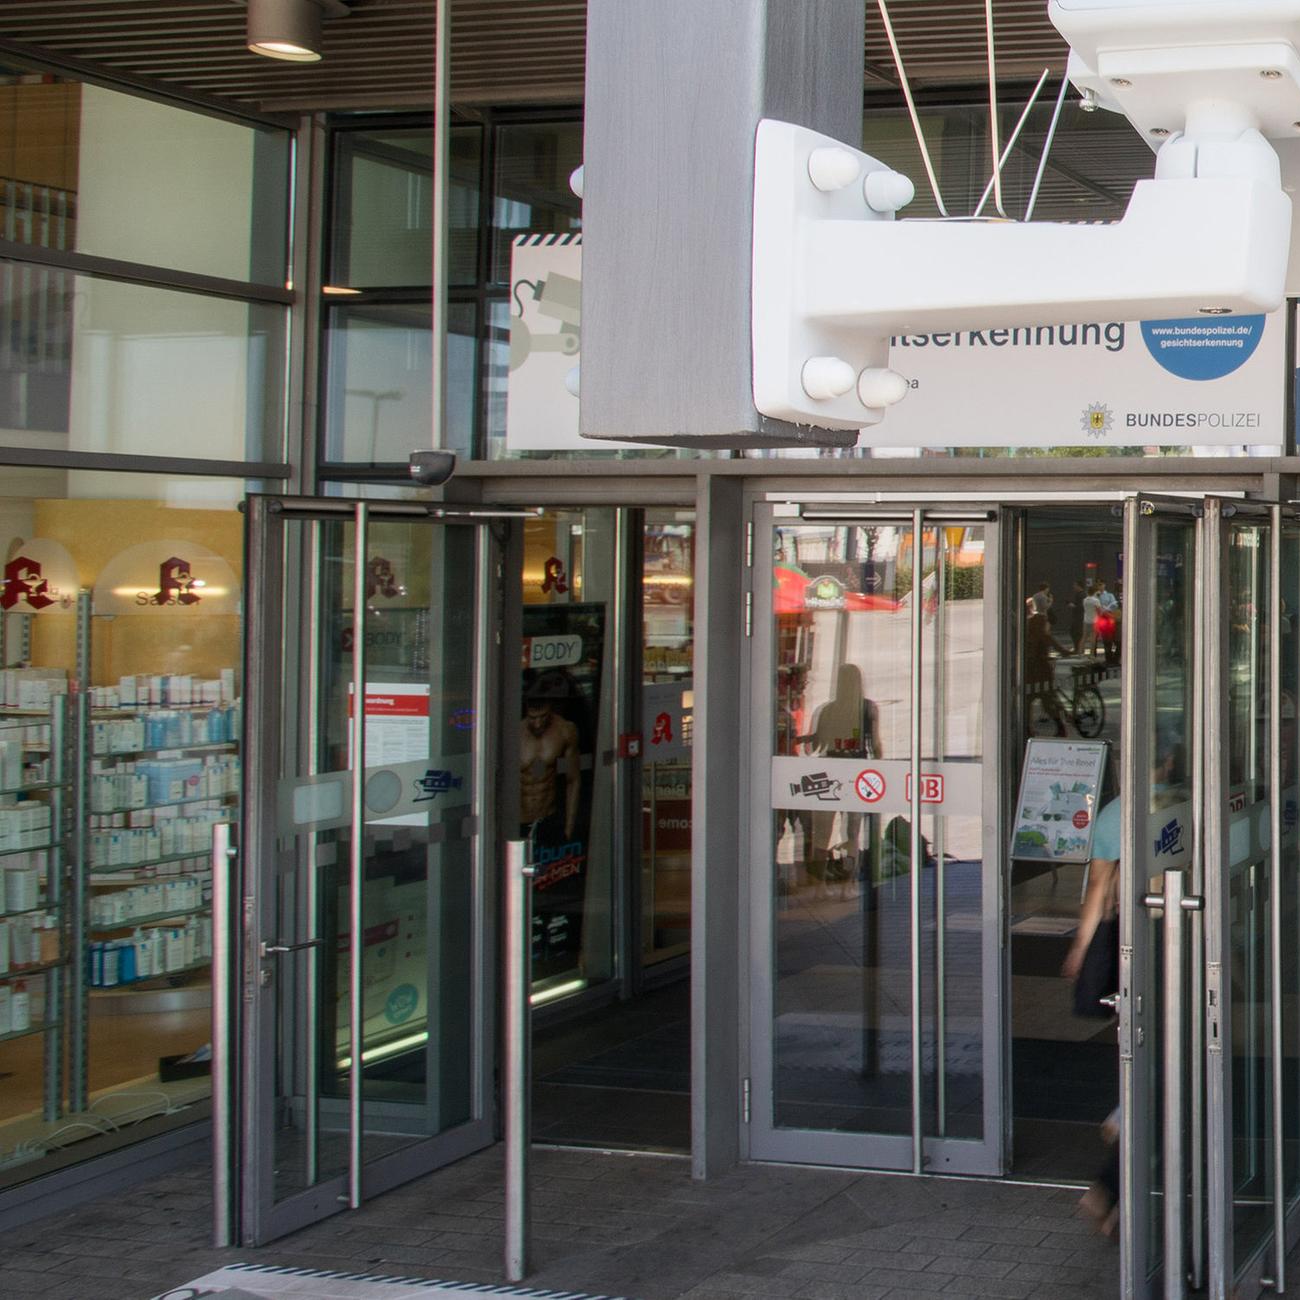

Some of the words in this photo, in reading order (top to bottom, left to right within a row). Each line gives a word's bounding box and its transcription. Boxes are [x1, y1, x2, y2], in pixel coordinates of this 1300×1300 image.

[1151, 325, 1253, 336] www.bundespolizei.de/
[1160, 338, 1244, 349] gesichtserkennung
[1126, 413, 1261, 428] BUNDESPOLIZEI
